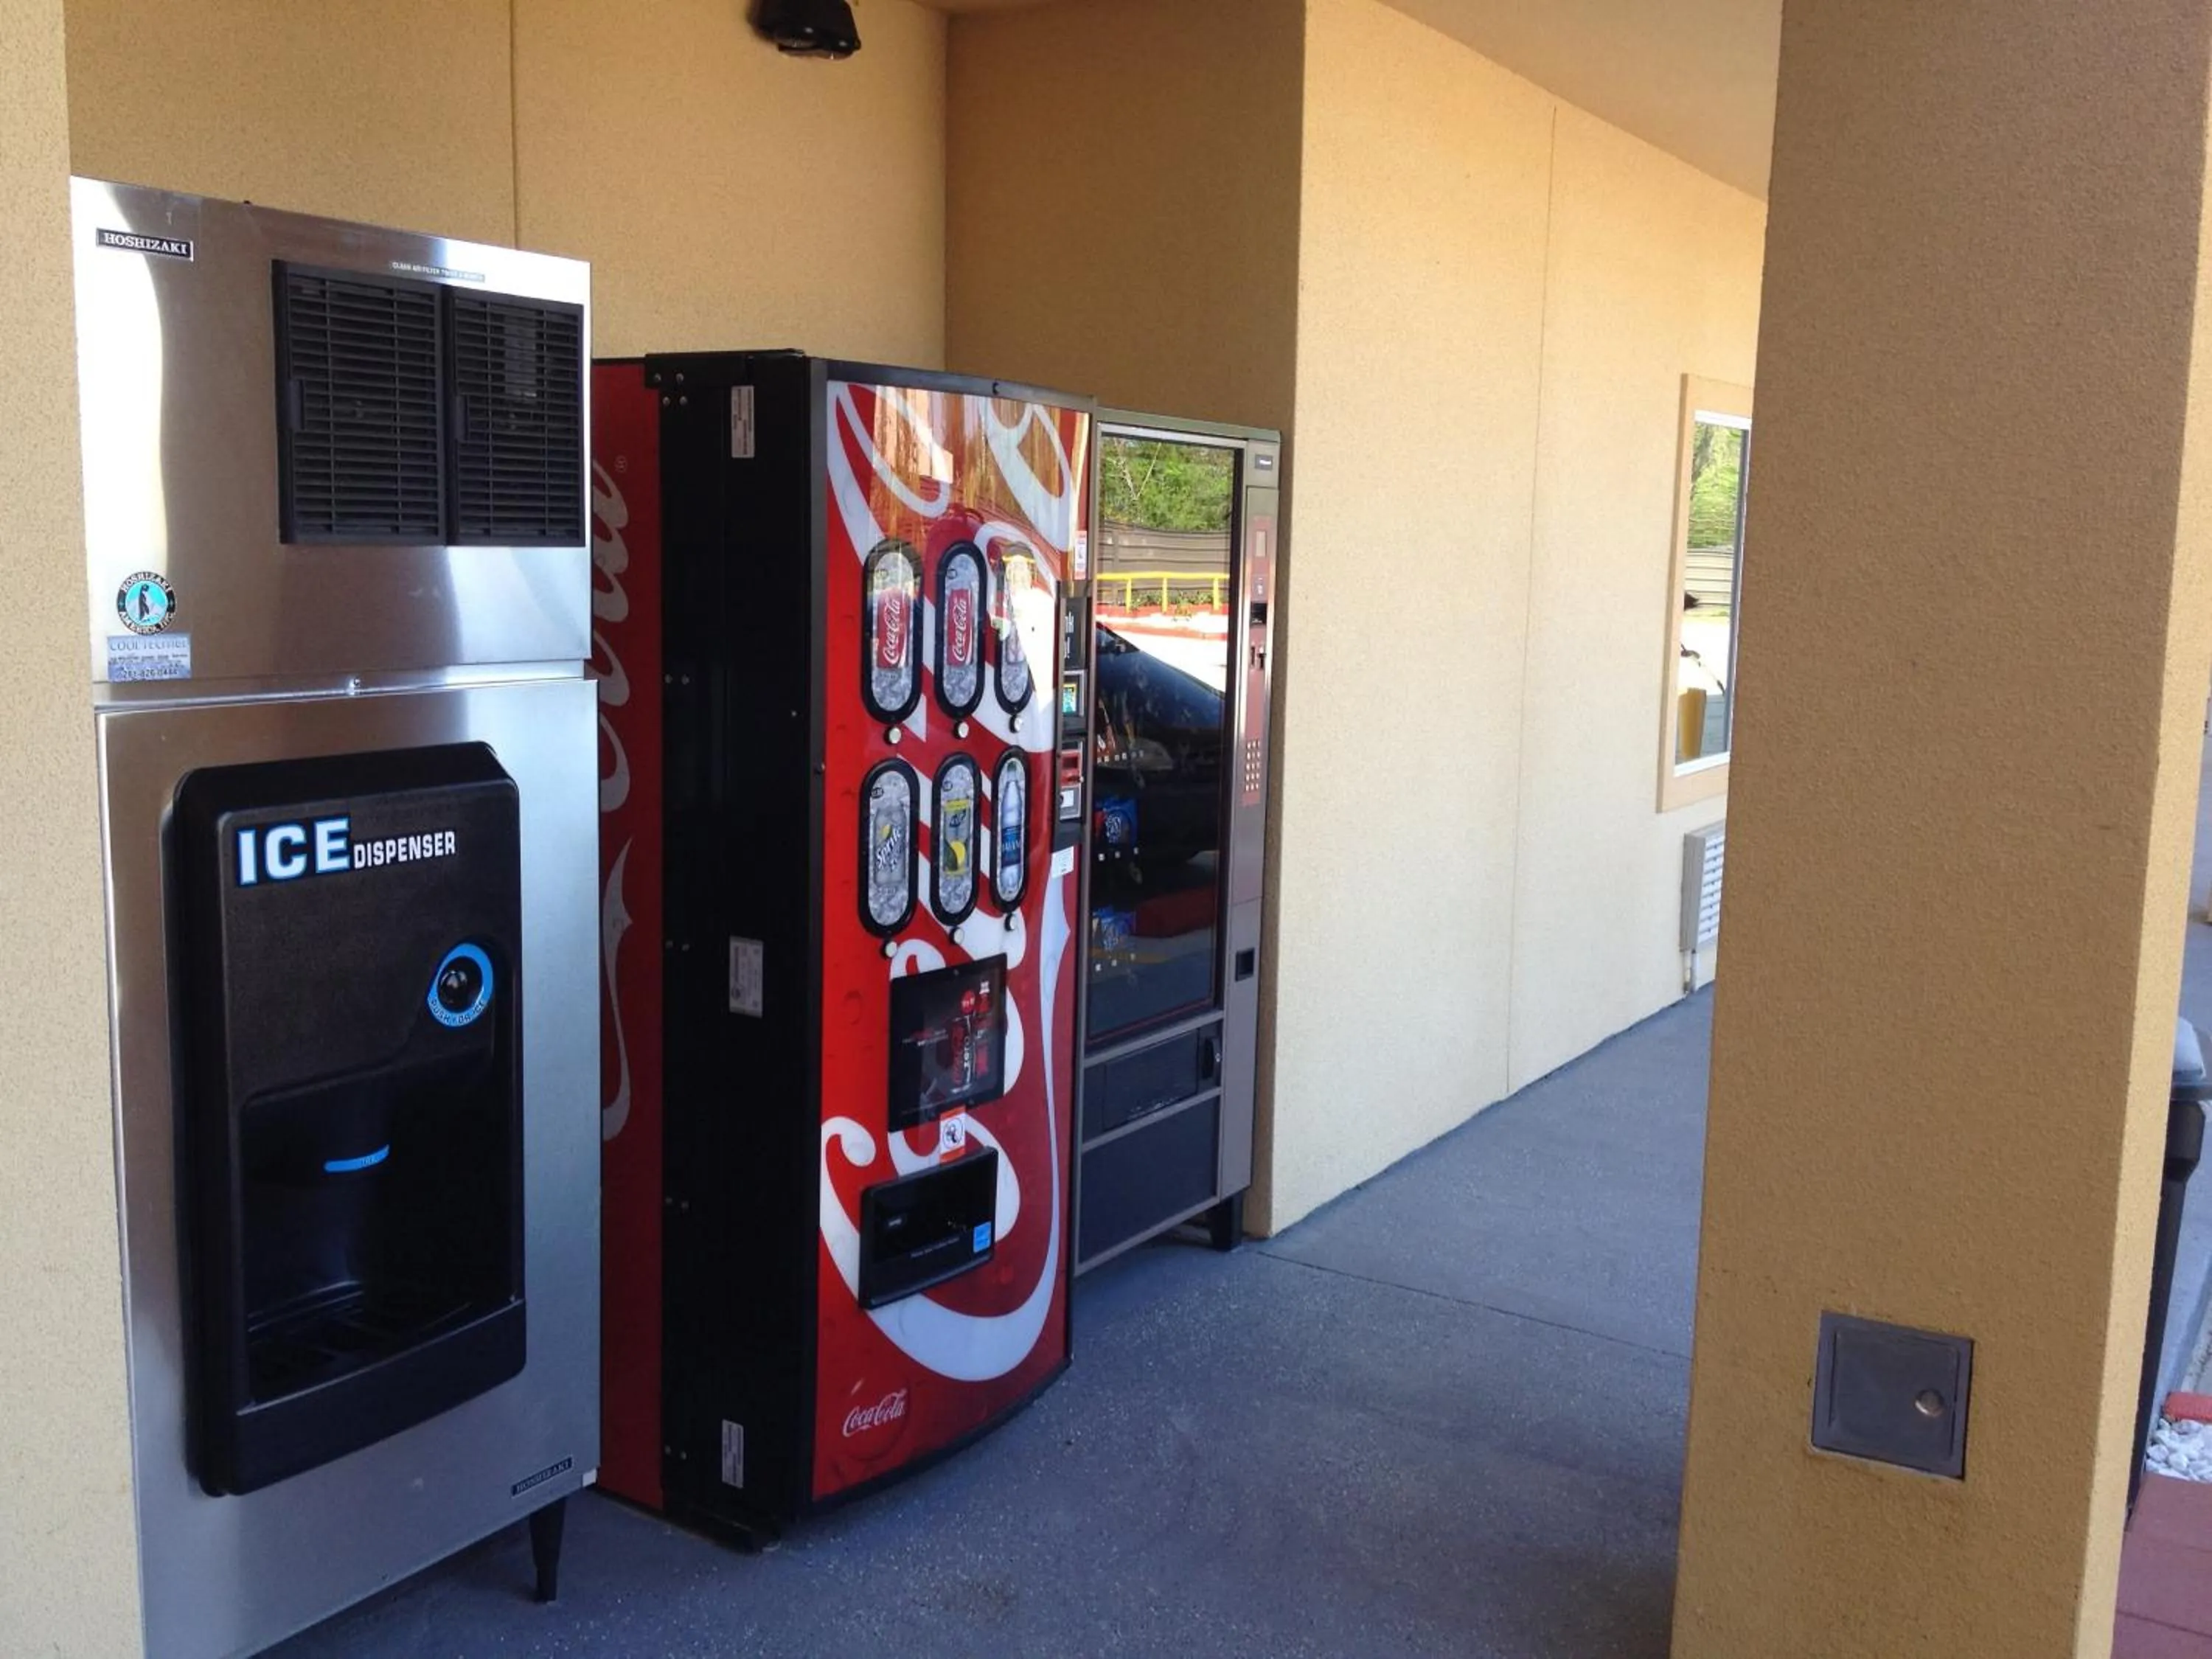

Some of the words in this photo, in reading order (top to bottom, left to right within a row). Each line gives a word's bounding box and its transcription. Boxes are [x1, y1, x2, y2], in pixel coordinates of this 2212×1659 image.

[103, 232, 187, 254] HOSHIZAKI
[120, 571, 173, 593] HOSHIZAKI
[883, 599, 900, 664] Coca-Cola
[952, 599, 967, 661] Coca-Cola
[238, 817, 350, 885] ICE
[352, 830, 456, 869] DISPENSER
[843, 1388, 906, 1438] Coca-Cola
[517, 1460, 569, 1492] HOSHIZAKI
